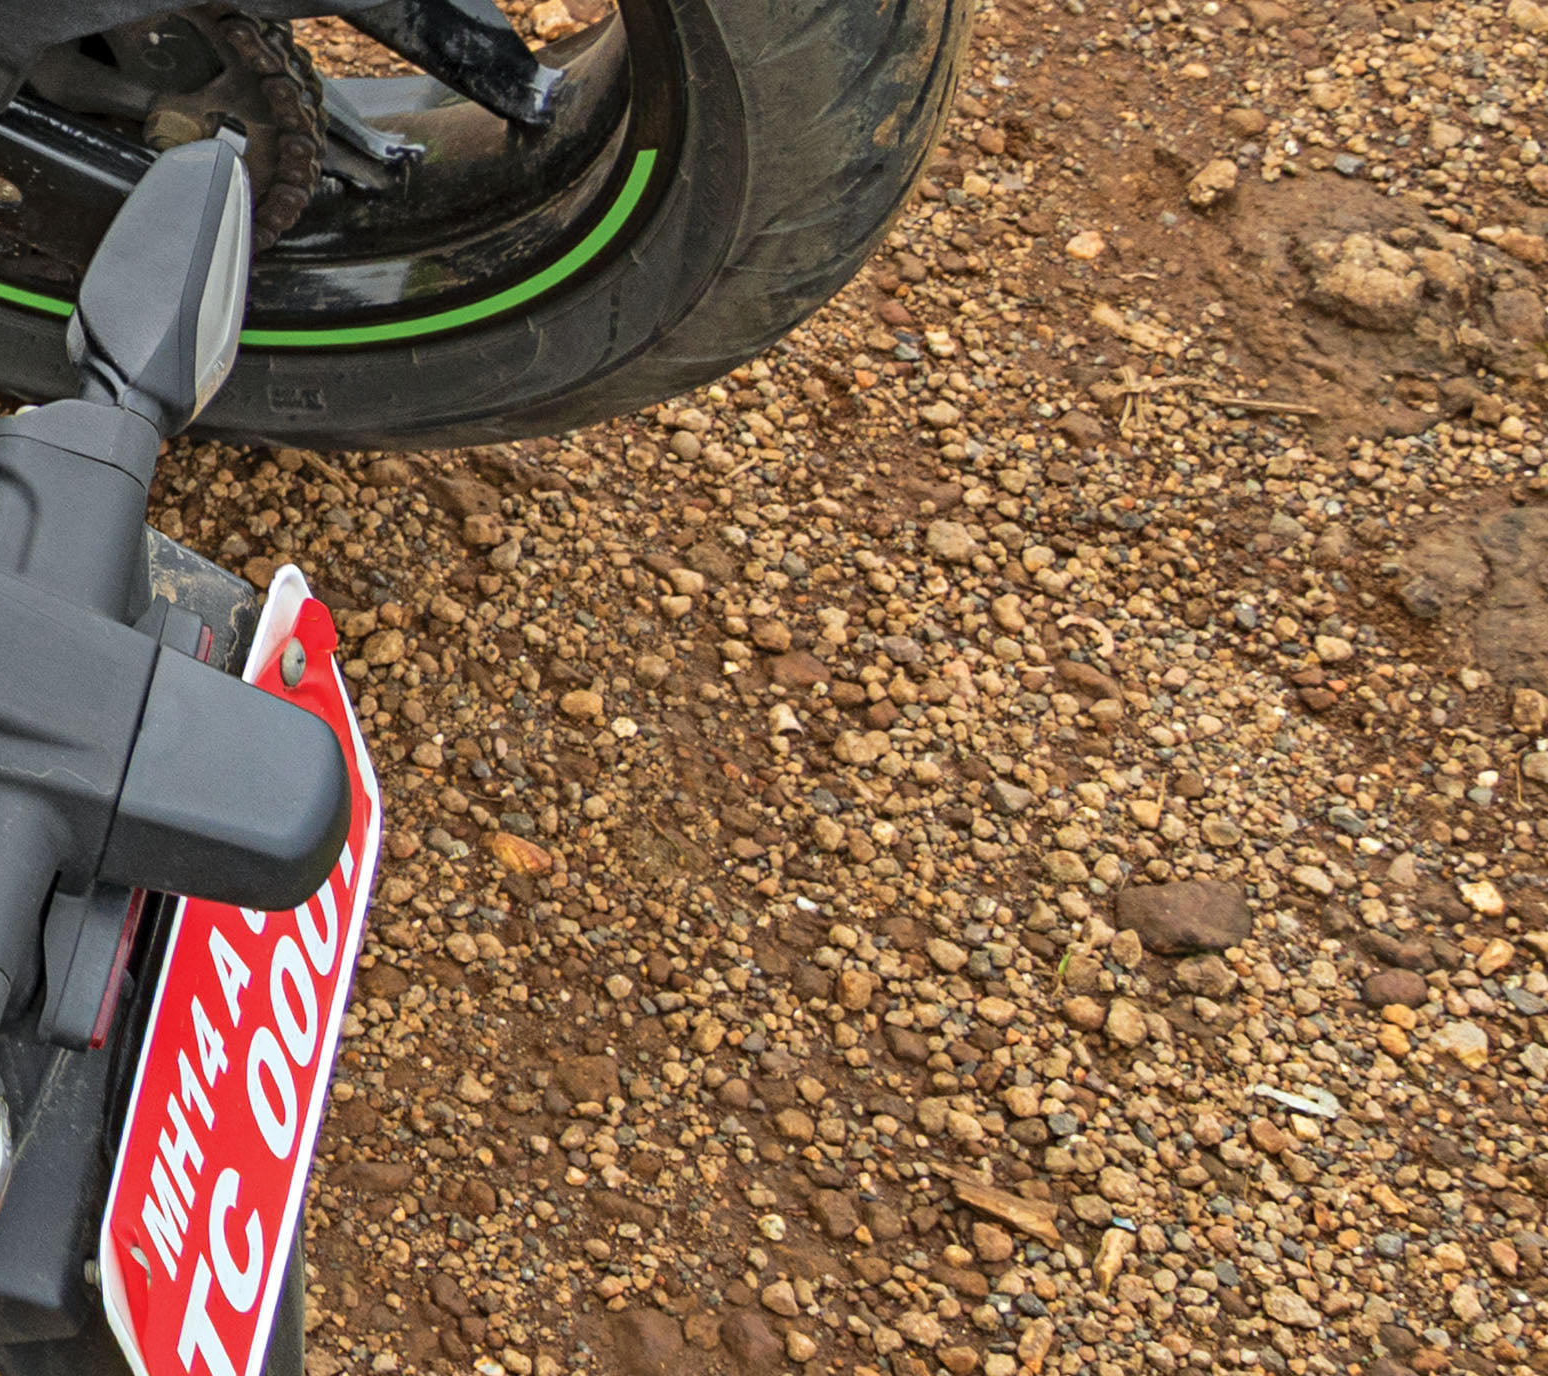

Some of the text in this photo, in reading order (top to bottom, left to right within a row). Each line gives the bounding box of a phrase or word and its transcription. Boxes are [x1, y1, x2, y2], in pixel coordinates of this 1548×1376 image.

[141, 925, 252, 1281] MH14 A
[176, 1167, 264, 1376] TC
